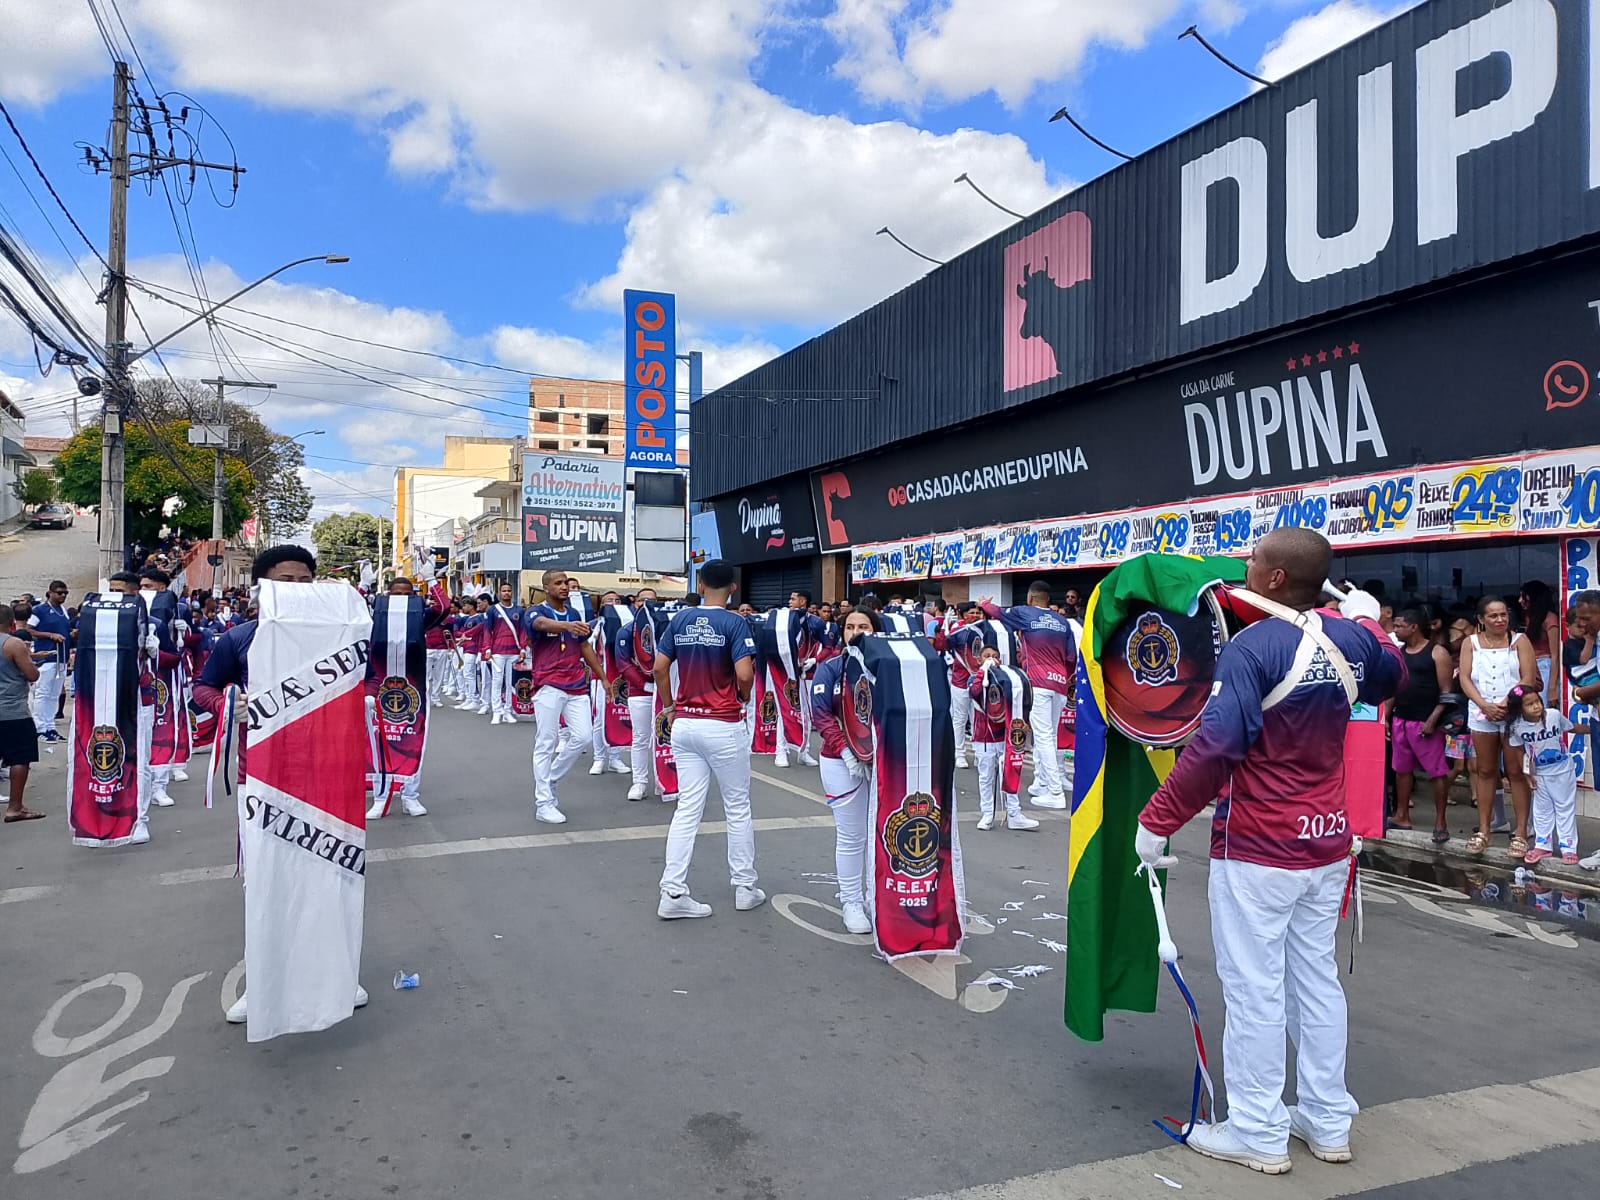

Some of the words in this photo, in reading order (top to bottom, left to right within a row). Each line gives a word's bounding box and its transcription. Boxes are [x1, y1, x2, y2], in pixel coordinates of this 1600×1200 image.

[1180, 0, 1600, 325] DUP
[635, 301, 665, 447] POSTO
[1180, 382, 1199, 398] CASA
[1199, 379, 1211, 394] DA
[1211, 371, 1236, 390] CARNE
[1183, 363, 1389, 486] DUPINA
[541, 457, 600, 474] Padaria
[630, 452, 673, 462] AGORA
[524, 472, 622, 500] Alternativa
[906, 446, 1089, 503] CASADACARNEDUPINA
[1419, 482, 1450, 504] PEIXE
[549, 519, 618, 543] DUPINA
[738, 497, 781, 539] Dupina
[1047, 671, 1067, 685] 2025
[1297, 810, 1346, 839] 2025
[898, 897, 928, 907] 2025
